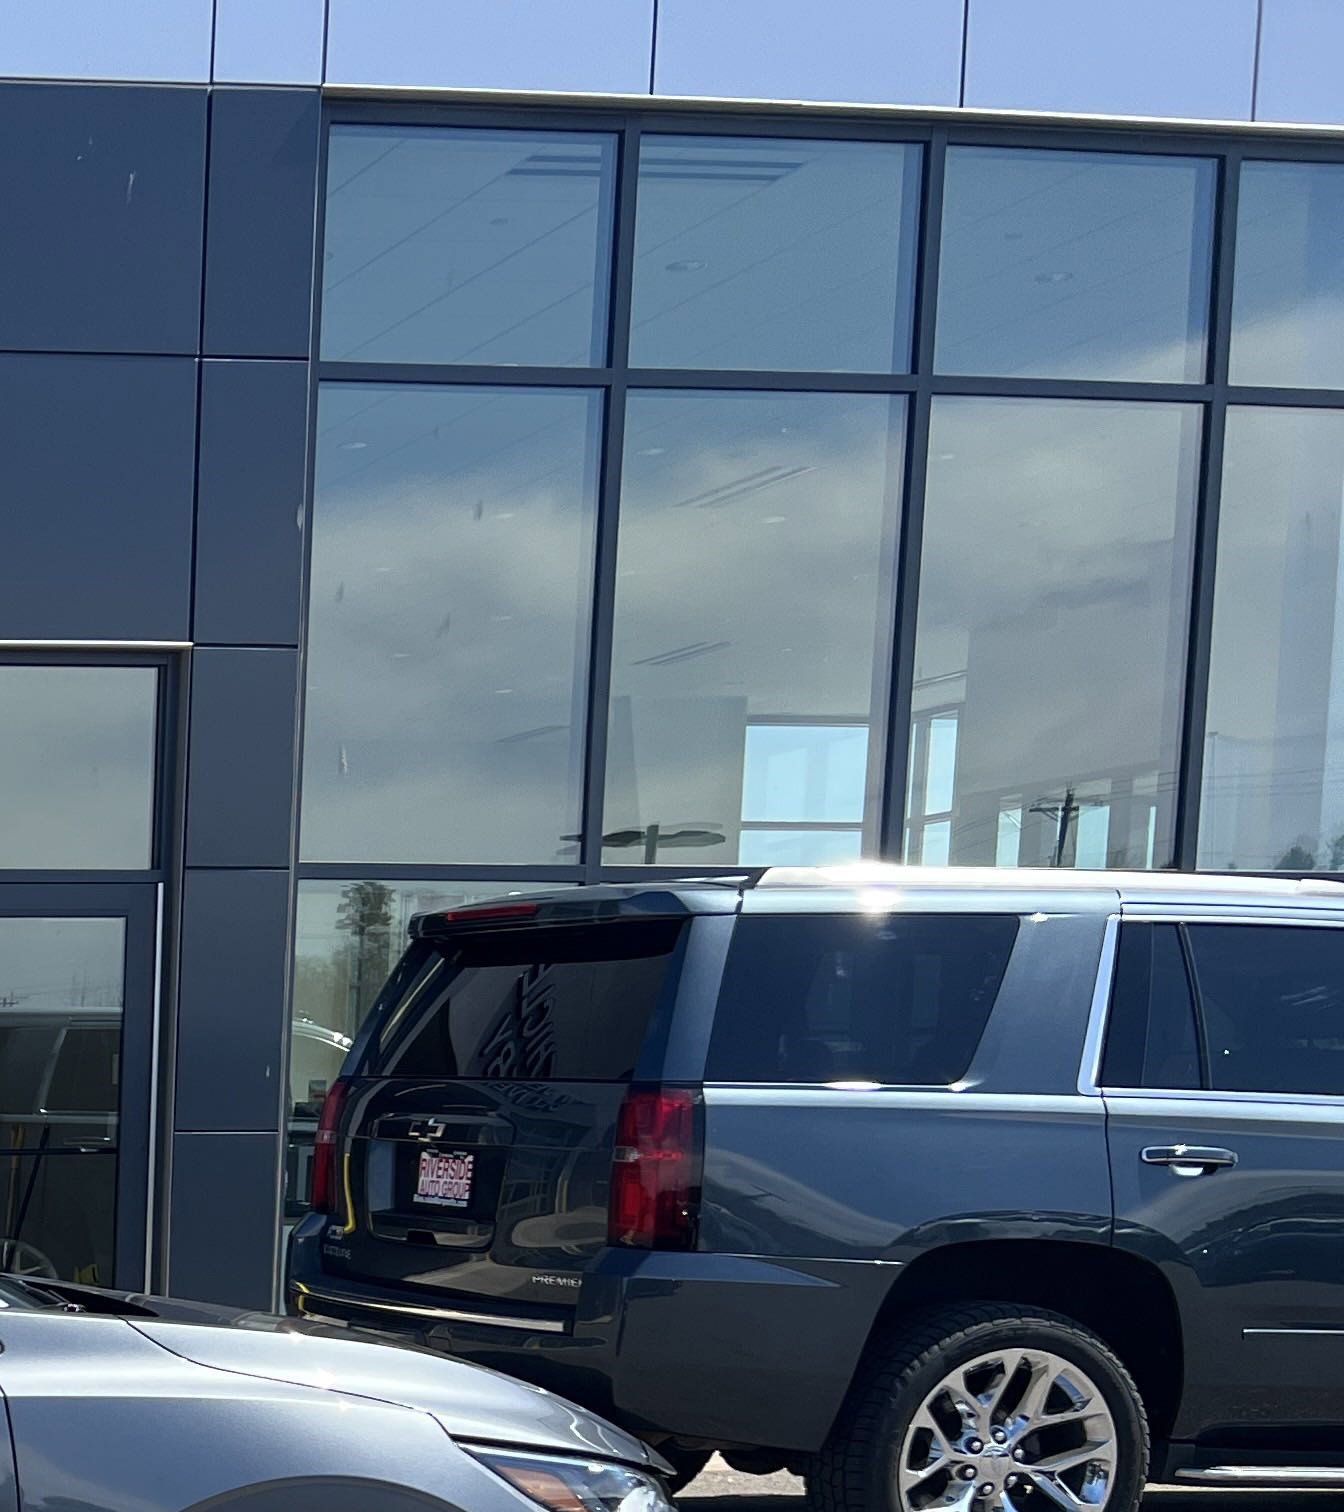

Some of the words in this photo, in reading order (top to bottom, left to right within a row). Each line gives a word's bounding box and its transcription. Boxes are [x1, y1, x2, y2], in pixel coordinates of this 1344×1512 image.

[419, 1157, 473, 1181] RIVERSIDE
[417, 1178, 440, 1197] AUTO
[441, 1180, 471, 1199] GROUP
